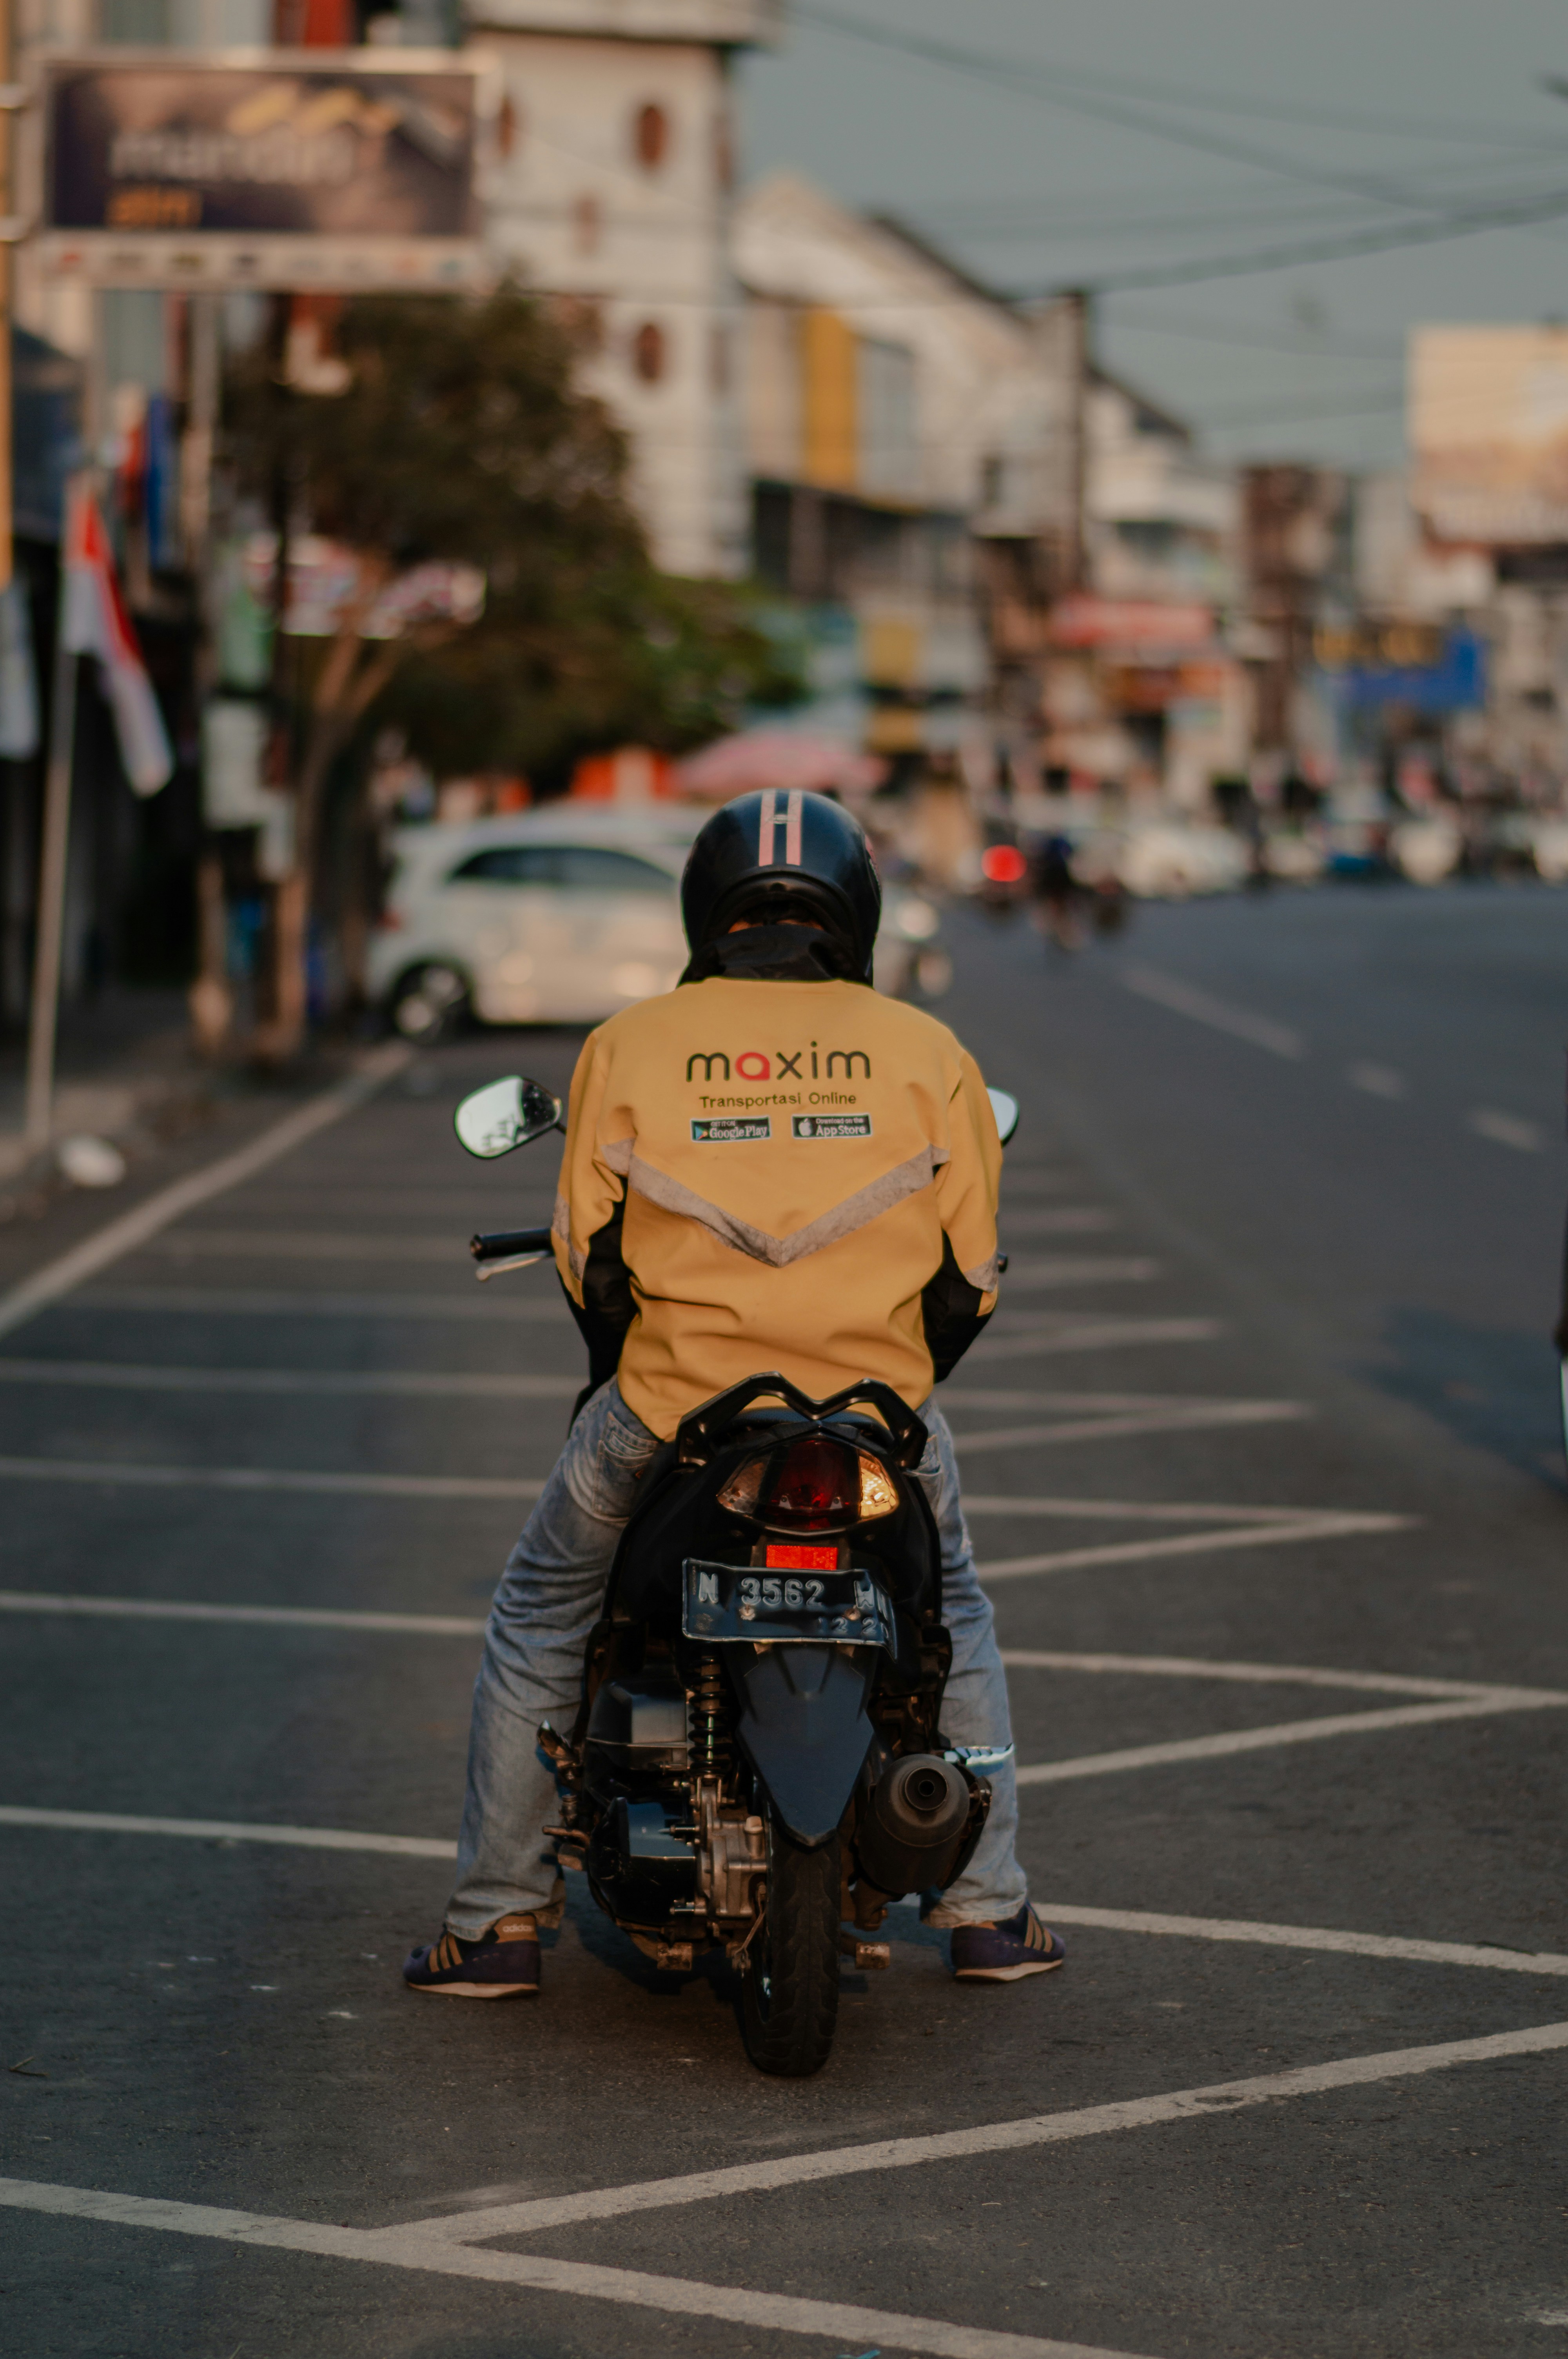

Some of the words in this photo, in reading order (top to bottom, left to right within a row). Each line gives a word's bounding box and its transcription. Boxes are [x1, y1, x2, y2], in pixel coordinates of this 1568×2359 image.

[686, 1040, 871, 1082] maxim
[699, 1092, 801, 1109] Transportasi
[809, 1092, 857, 1105] Online
[710, 1127, 744, 1140] Google
[745, 1125, 768, 1138] Play
[816, 1125, 838, 1137] App
[838, 1125, 866, 1134] Store
[699, 1572, 719, 1603] N
[741, 1577, 824, 1606] 3562
